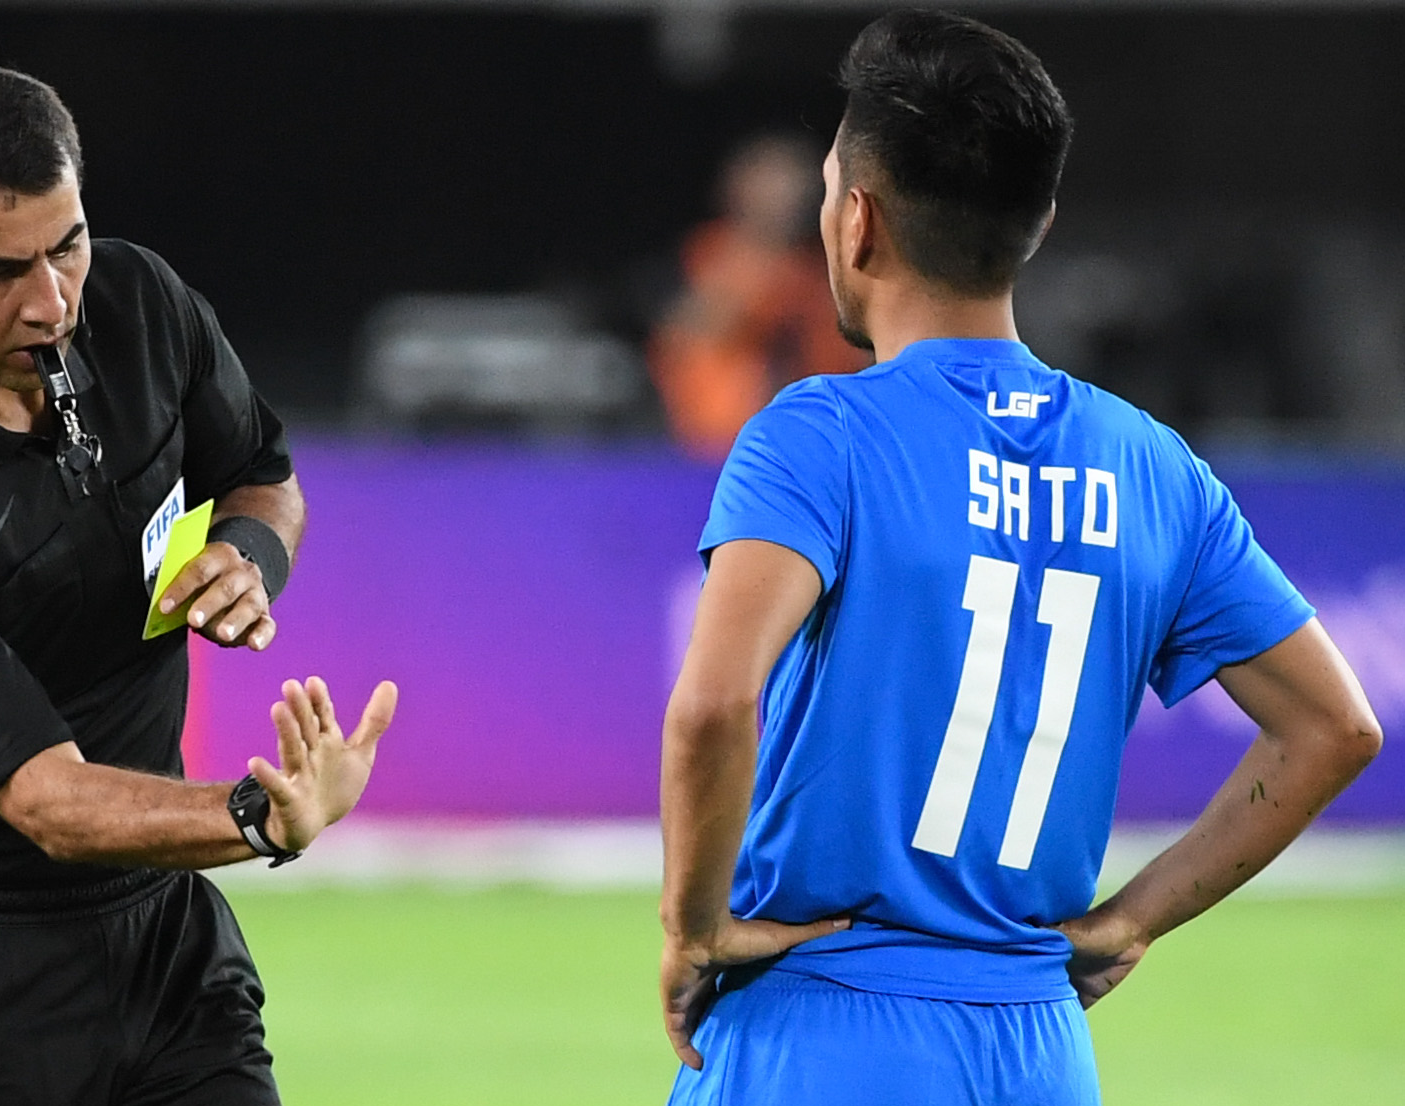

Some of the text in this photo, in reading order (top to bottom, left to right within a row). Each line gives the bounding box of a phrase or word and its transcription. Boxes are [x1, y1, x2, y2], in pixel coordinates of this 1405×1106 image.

[147, 496, 180, 554] FIFA
[967, 448, 1119, 549] SATO
[911, 554, 1101, 871] 11
